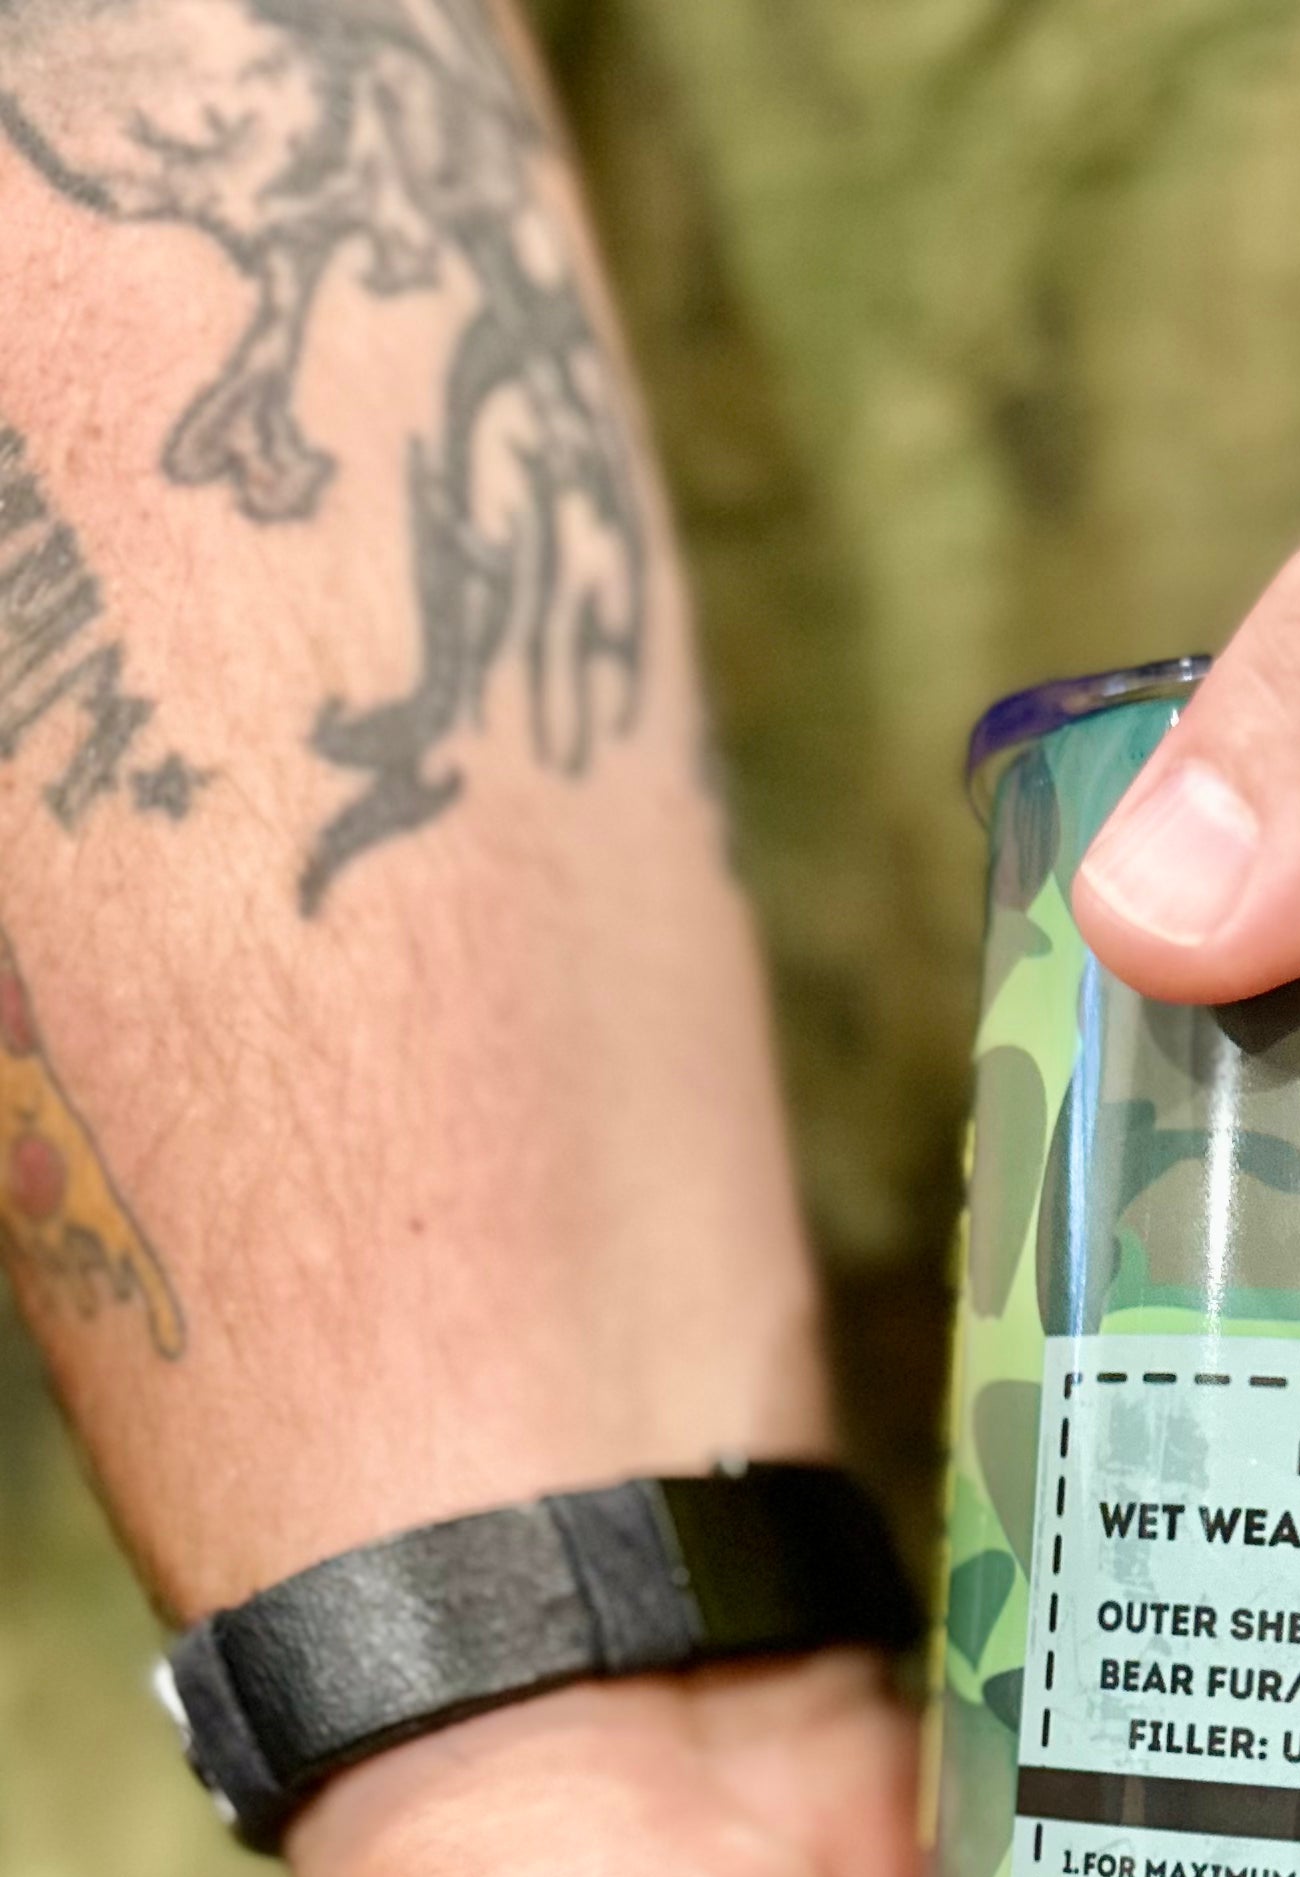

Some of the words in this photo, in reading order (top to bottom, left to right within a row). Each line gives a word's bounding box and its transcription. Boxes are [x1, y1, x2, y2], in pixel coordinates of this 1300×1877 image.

[1100, 1502, 1185, 1541] WET
[1098, 1601, 1216, 1638] OUTER
[1100, 1660, 1194, 1696] BEAR
[1129, 1720, 1267, 1761] FILLER:
